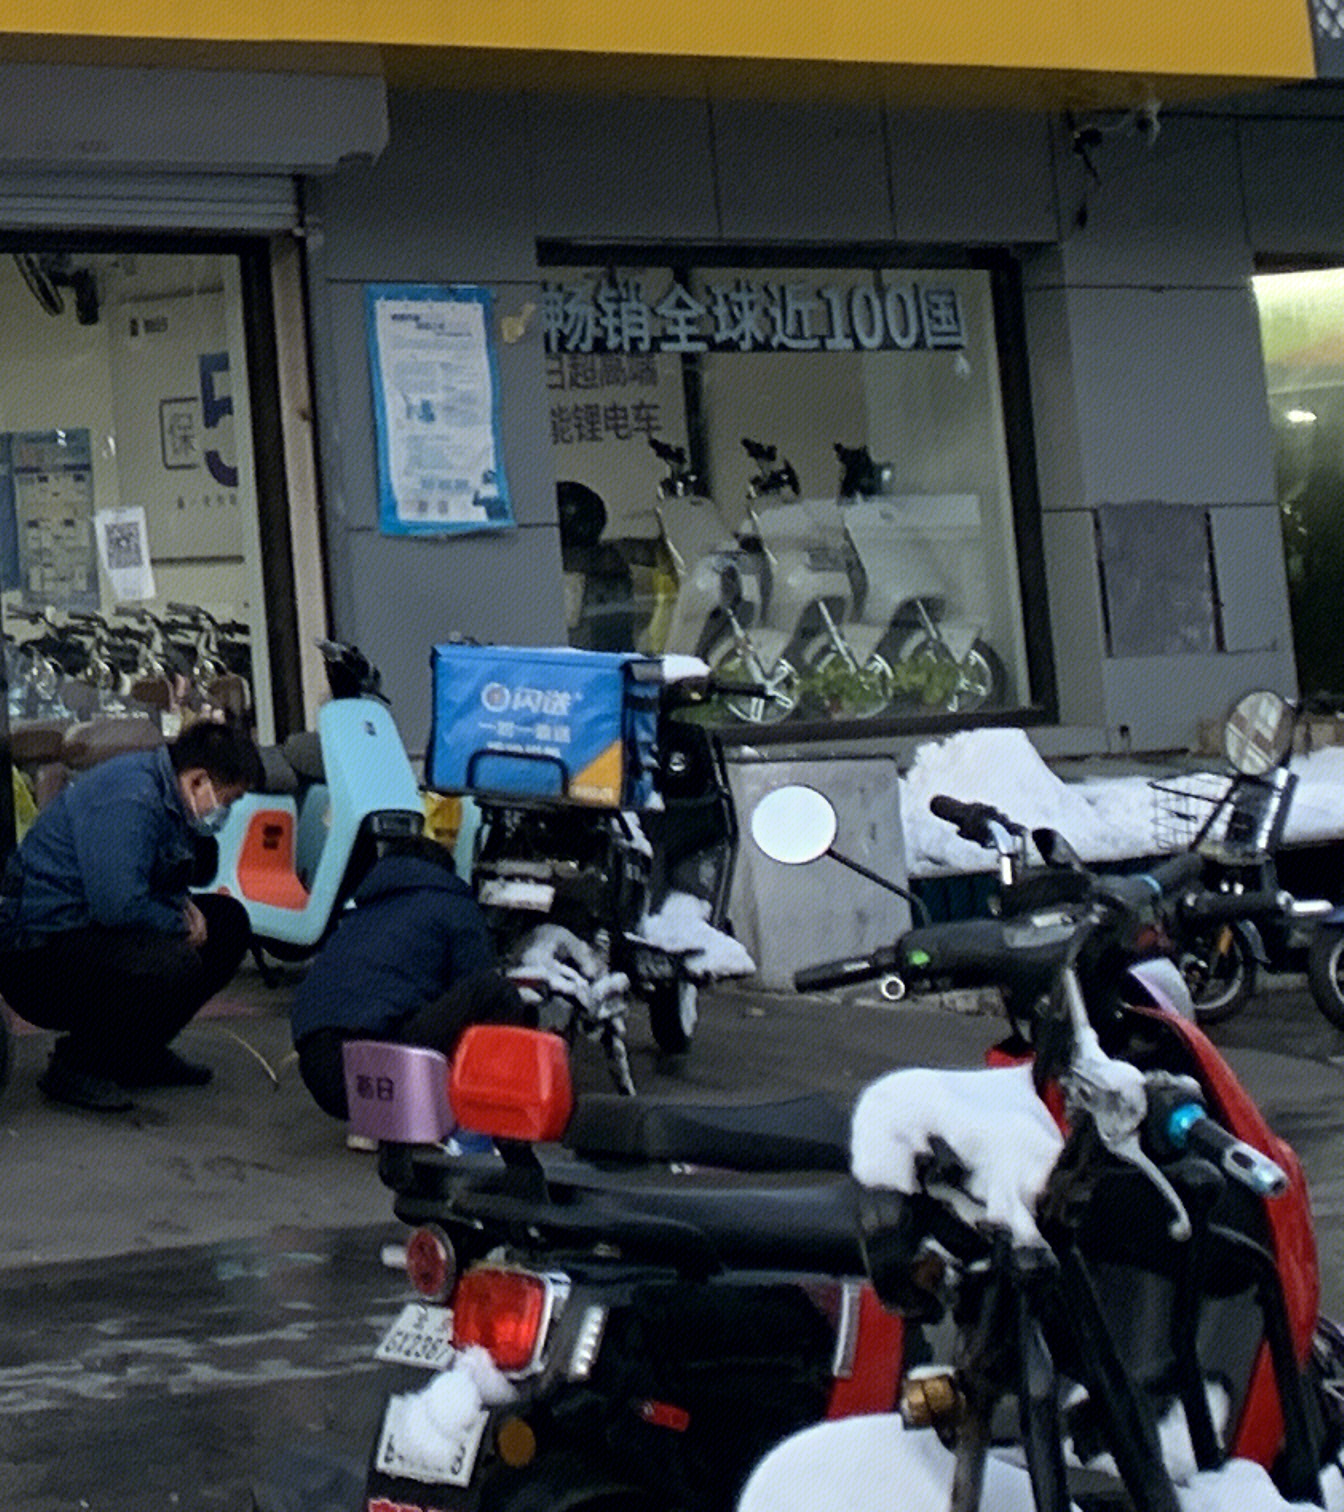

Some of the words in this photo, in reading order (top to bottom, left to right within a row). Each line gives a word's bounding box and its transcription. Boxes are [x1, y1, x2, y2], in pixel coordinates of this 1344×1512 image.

[542, 280, 968, 354] 畅销全球近100国
